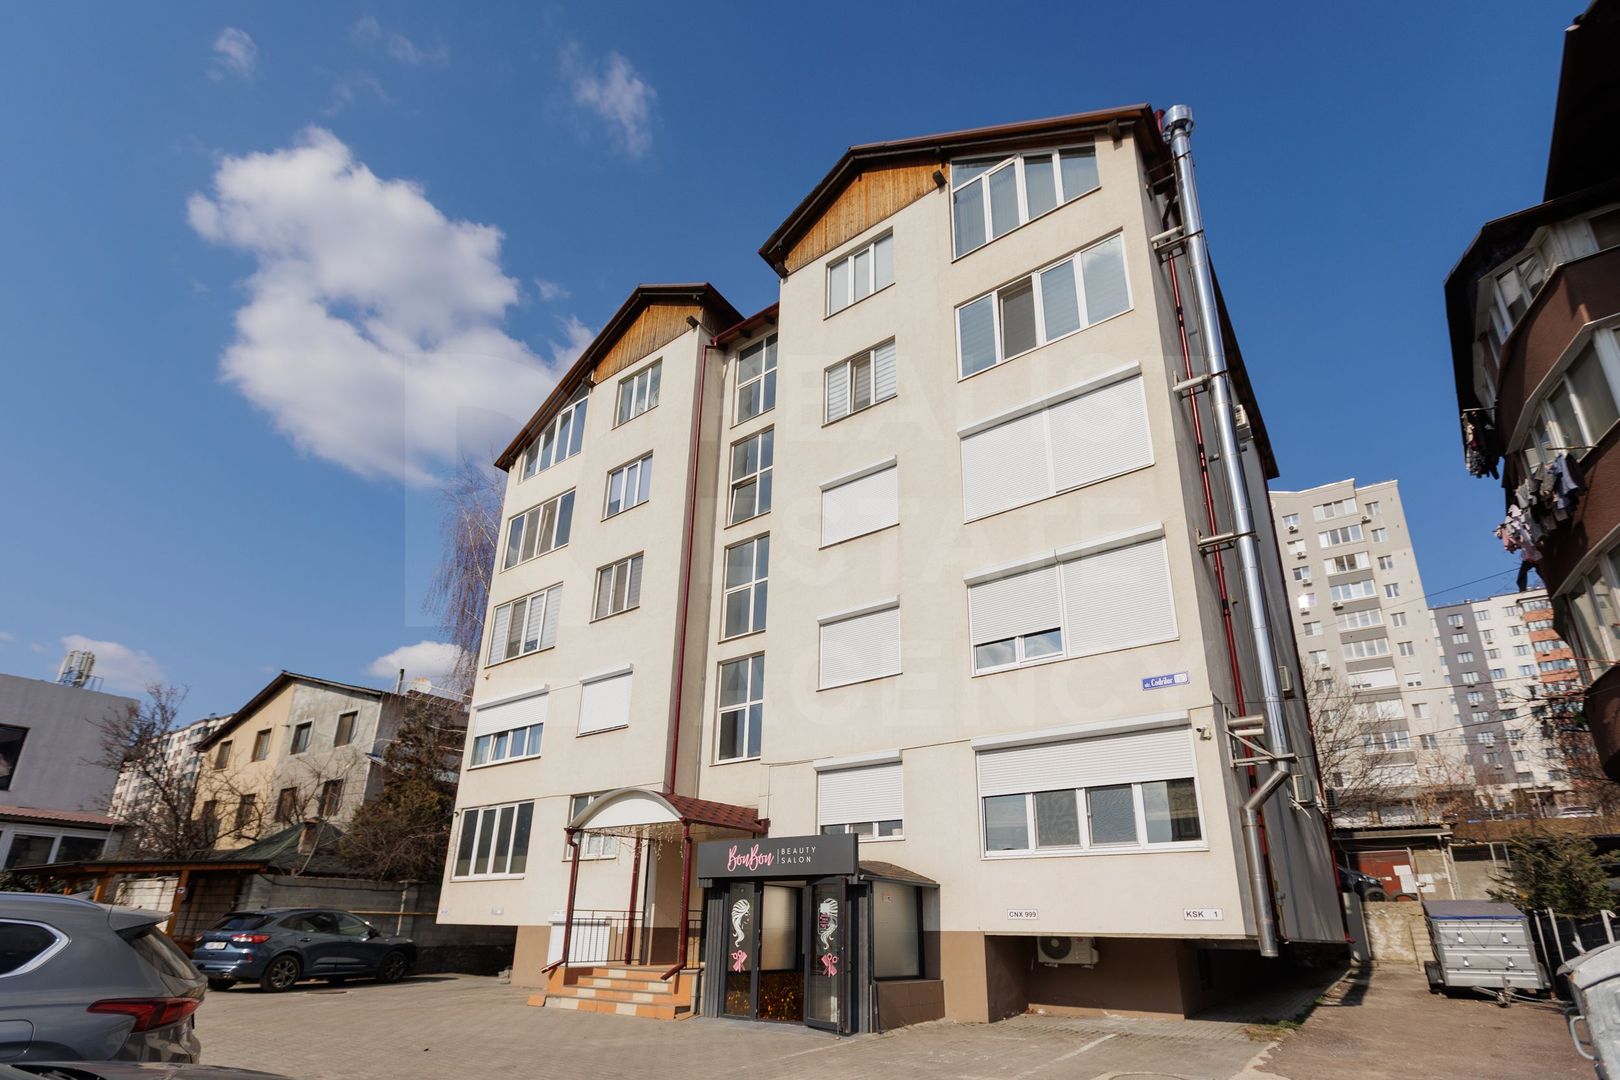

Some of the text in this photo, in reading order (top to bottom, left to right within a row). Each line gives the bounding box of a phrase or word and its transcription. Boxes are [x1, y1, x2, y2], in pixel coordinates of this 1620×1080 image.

[781, 847, 816, 855] BEAUTY
[727, 844, 775, 871] BonBon
[781, 856, 811, 864] SALON
[1185, 910, 1205, 918] KSK
